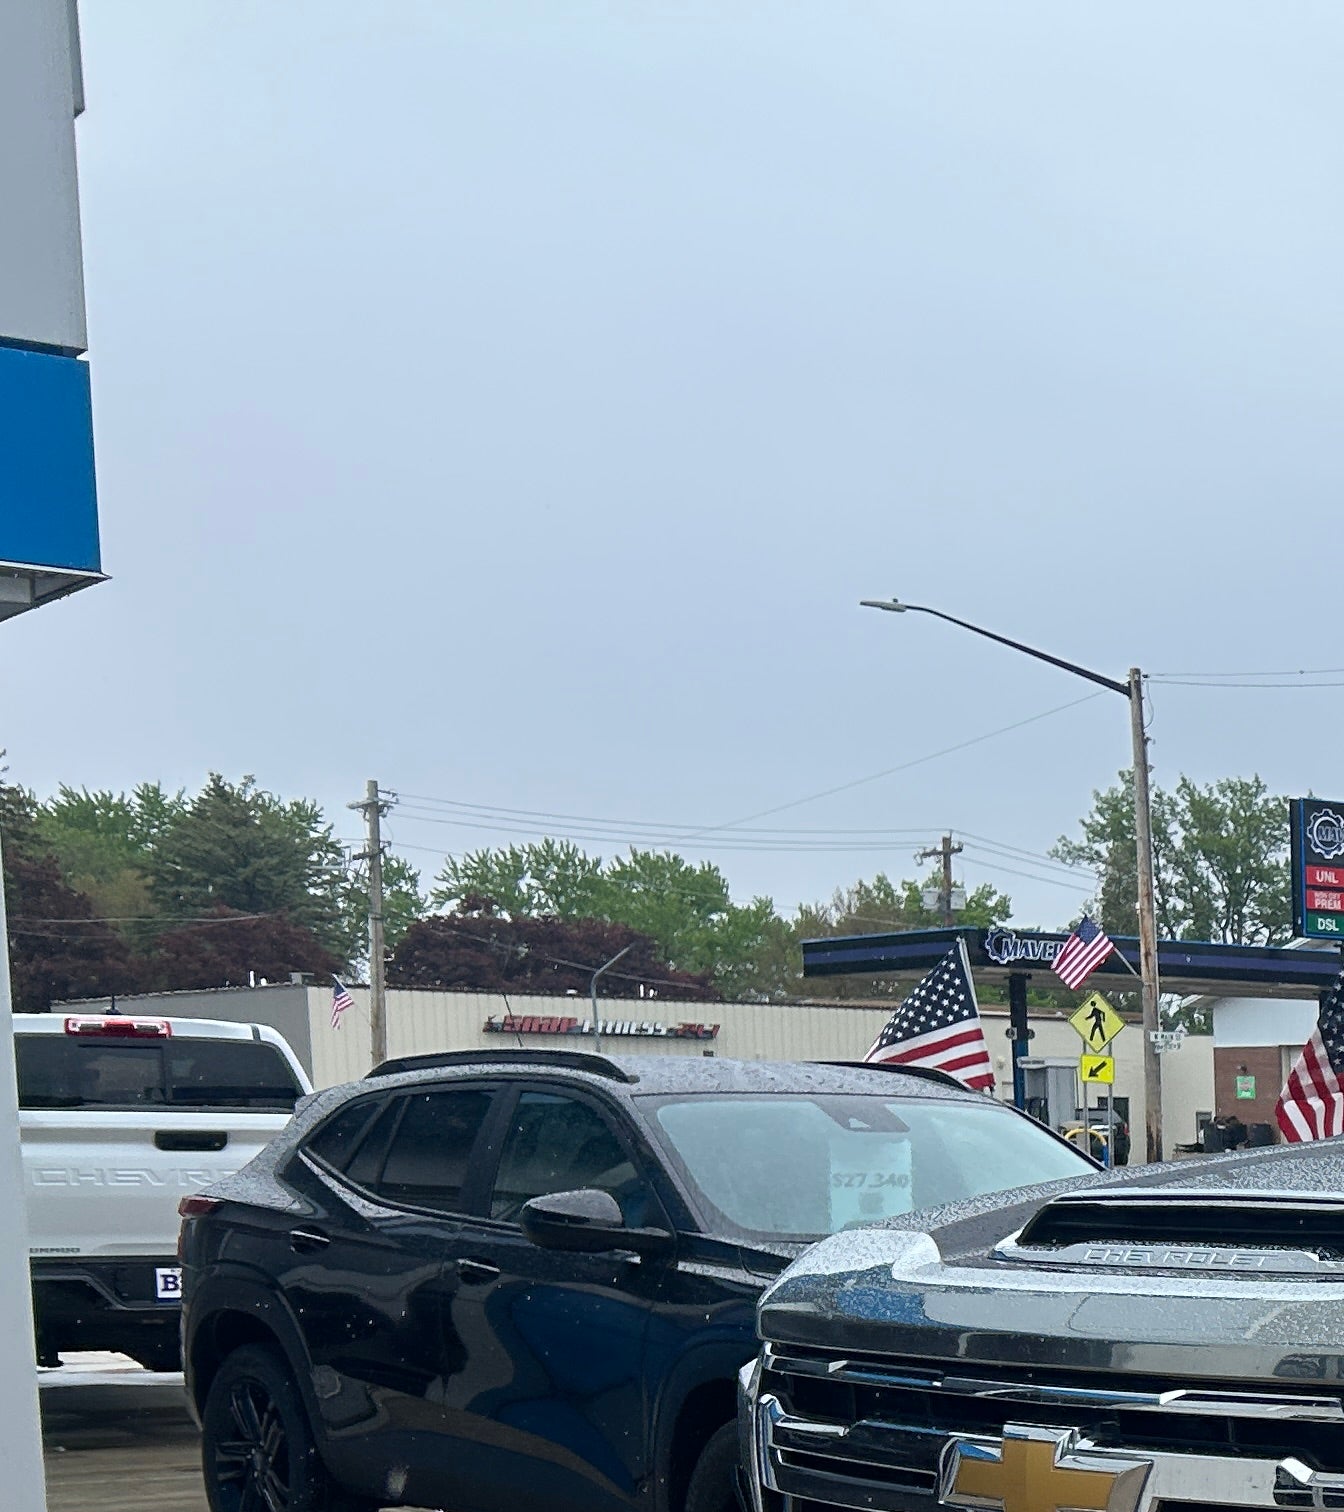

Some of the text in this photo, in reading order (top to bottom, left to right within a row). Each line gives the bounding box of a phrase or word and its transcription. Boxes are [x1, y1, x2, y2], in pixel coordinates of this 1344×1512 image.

[1315, 869, 1339, 884] UNL
[1314, 898, 1342, 910] PREM
[1317, 918, 1339, 931] DSL
[1084, 1248, 1279, 1267] CHEVROLET
[160, 1274, 182, 1291] B
